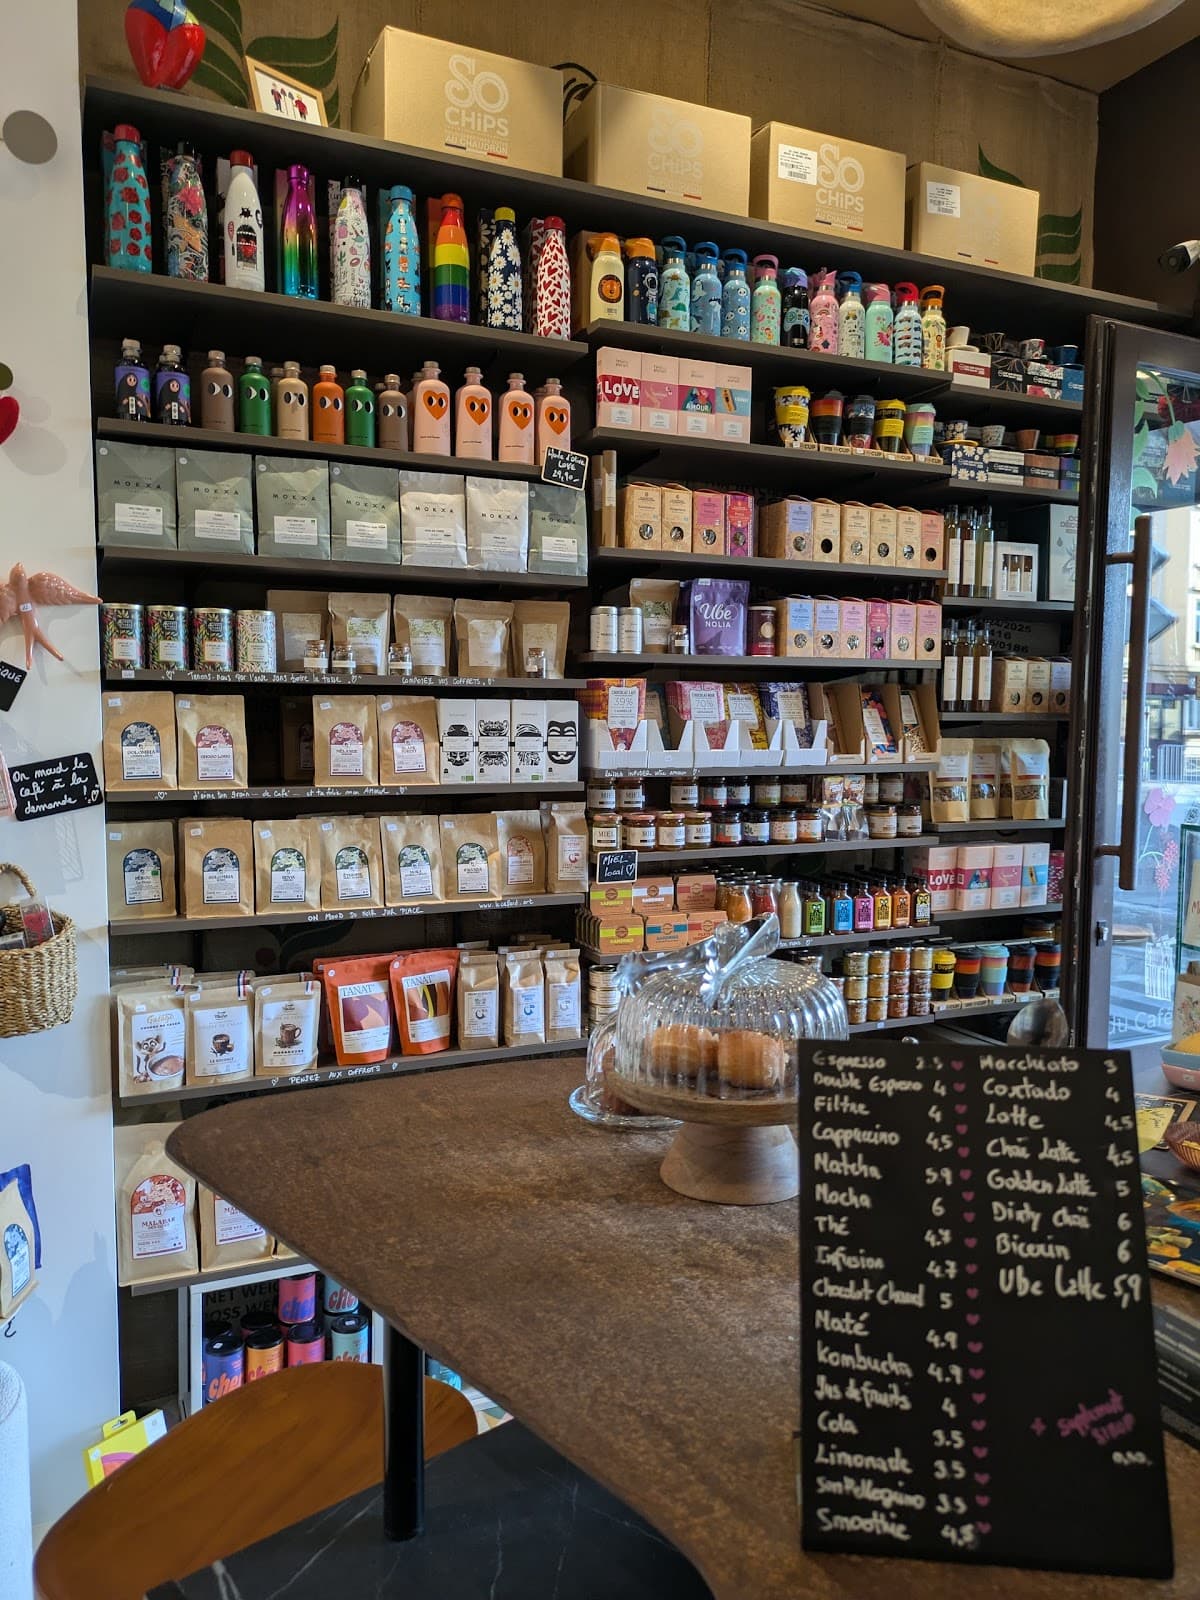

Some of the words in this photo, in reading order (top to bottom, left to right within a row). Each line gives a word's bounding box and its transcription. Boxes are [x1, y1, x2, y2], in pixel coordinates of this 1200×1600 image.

[445, 54, 509, 112] SO
[817, 143, 865, 193] SO
[604, 380, 640, 400] LOVE
[685, 402, 709, 412] AMOUR
[700, 603, 732, 620] Ube
[0, 665, 22, 683] QUE
[73, 757, 88, 769] le
[71, 772, 88, 786] la
[25, 794, 78, 814] demande
[929, 874, 955, 886] LOVE
[342, 984, 373, 997] TANAT
[405, 975, 433, 988] TANAT
[934, 1080, 947, 1096] 4
[1104, 1087, 1119, 1103] 4
[814, 1095, 871, 1116] Filtre
[928, 1105, 942, 1122] 4
[985, 1168, 1053, 1195] Golden
[1114, 1180, 1130, 1198] 5
[931, 1197, 945, 1216] 6
[1116, 1212, 1132, 1231] 6
[1116, 1239, 1132, 1263] 6
[998, 1264, 1043, 1297] Ube
[939, 1292, 954, 1310] 5
[941, 1397, 956, 1419] 4
[817, 1410, 859, 1435] Cola
[932, 1429, 965, 1449] 3.5
[814, 1442, 913, 1474] Limonade
[816, 1507, 911, 1541] Smoothie
